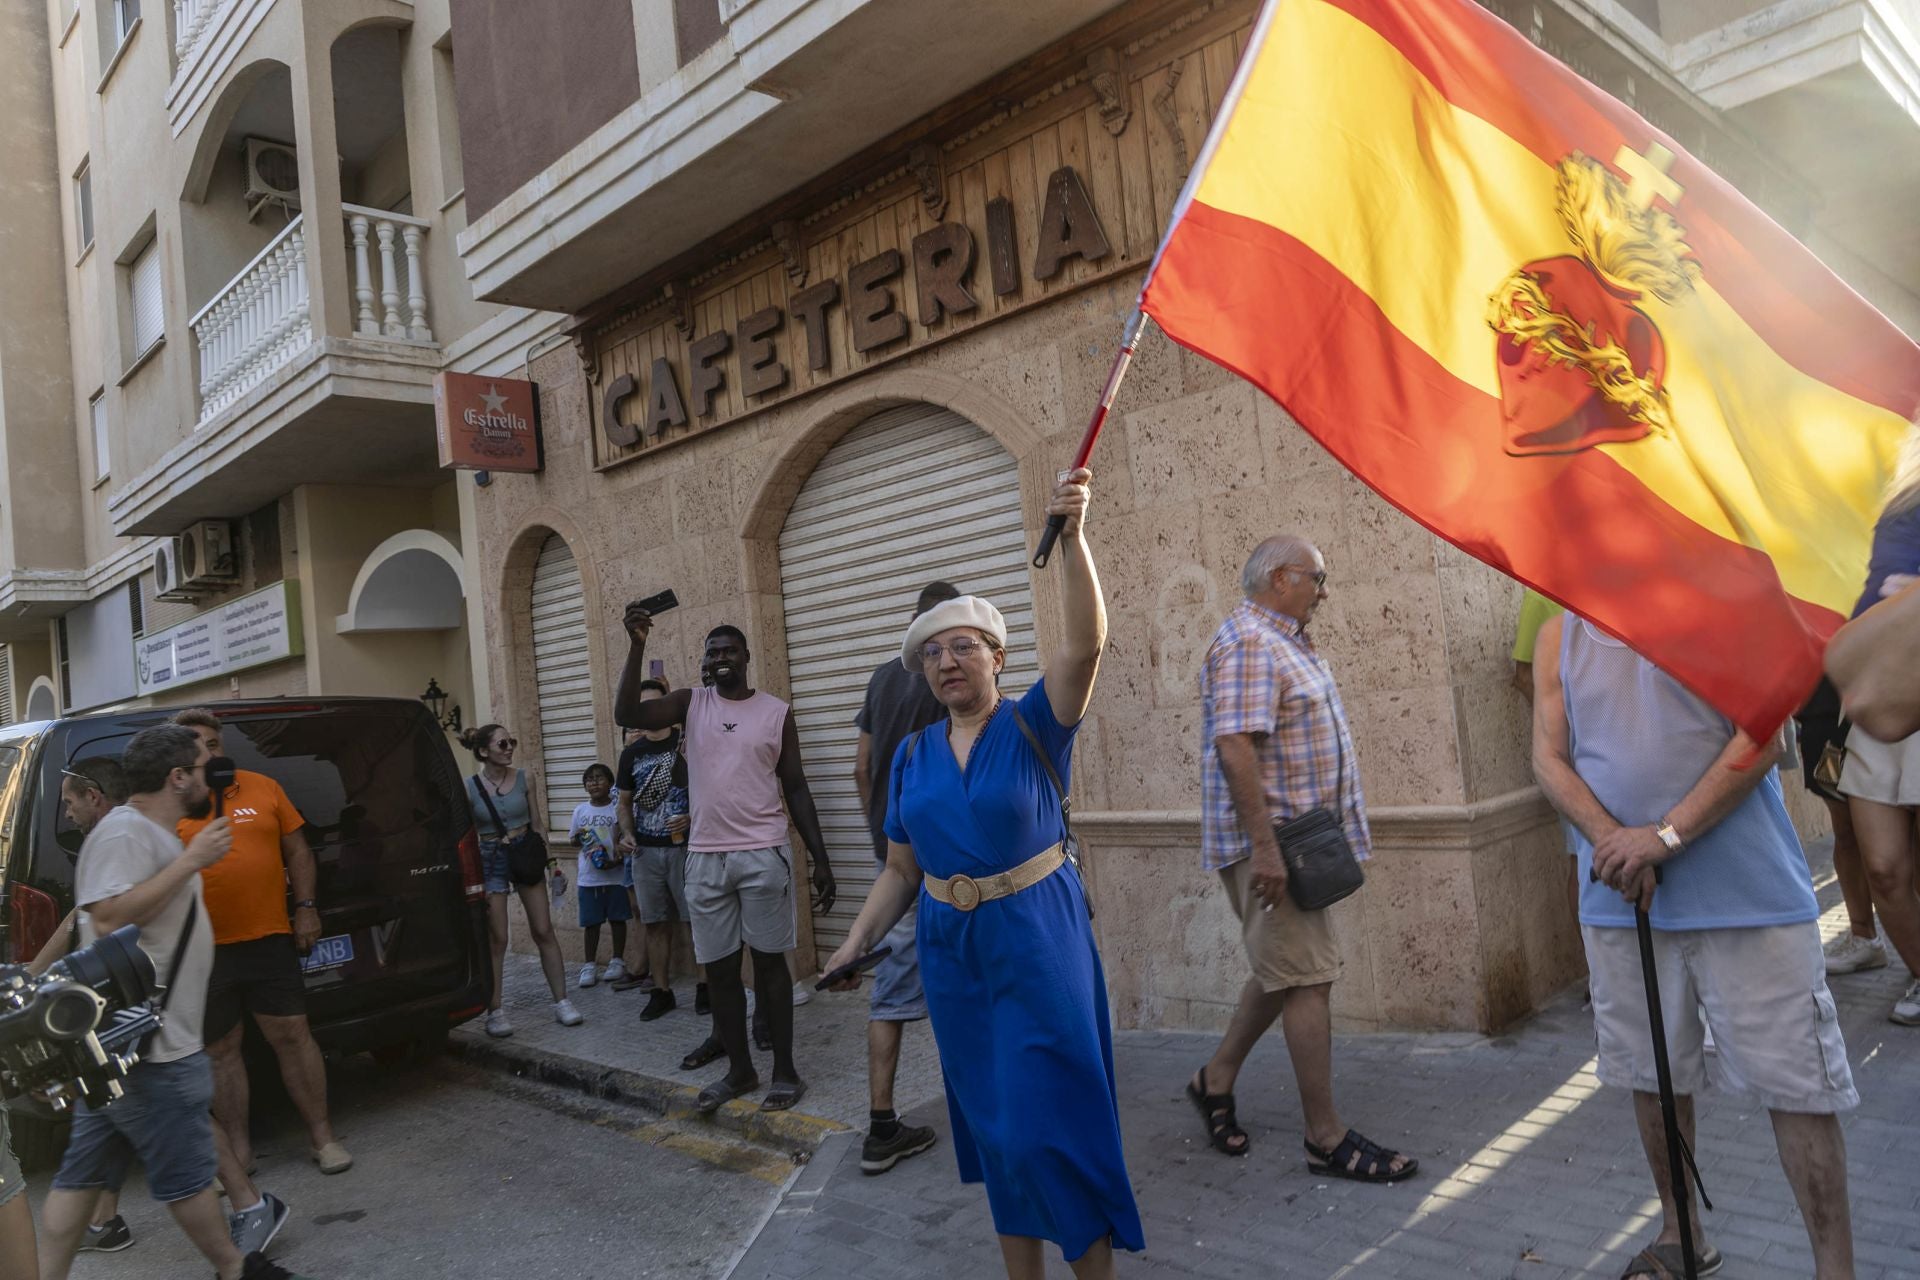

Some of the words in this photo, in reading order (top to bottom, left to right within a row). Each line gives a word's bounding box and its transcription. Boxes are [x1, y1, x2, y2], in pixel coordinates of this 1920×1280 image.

[603, 166, 1109, 447] CAFETERIA
[464, 408, 527, 430] Estrella
[580, 815, 613, 827] GUESS
